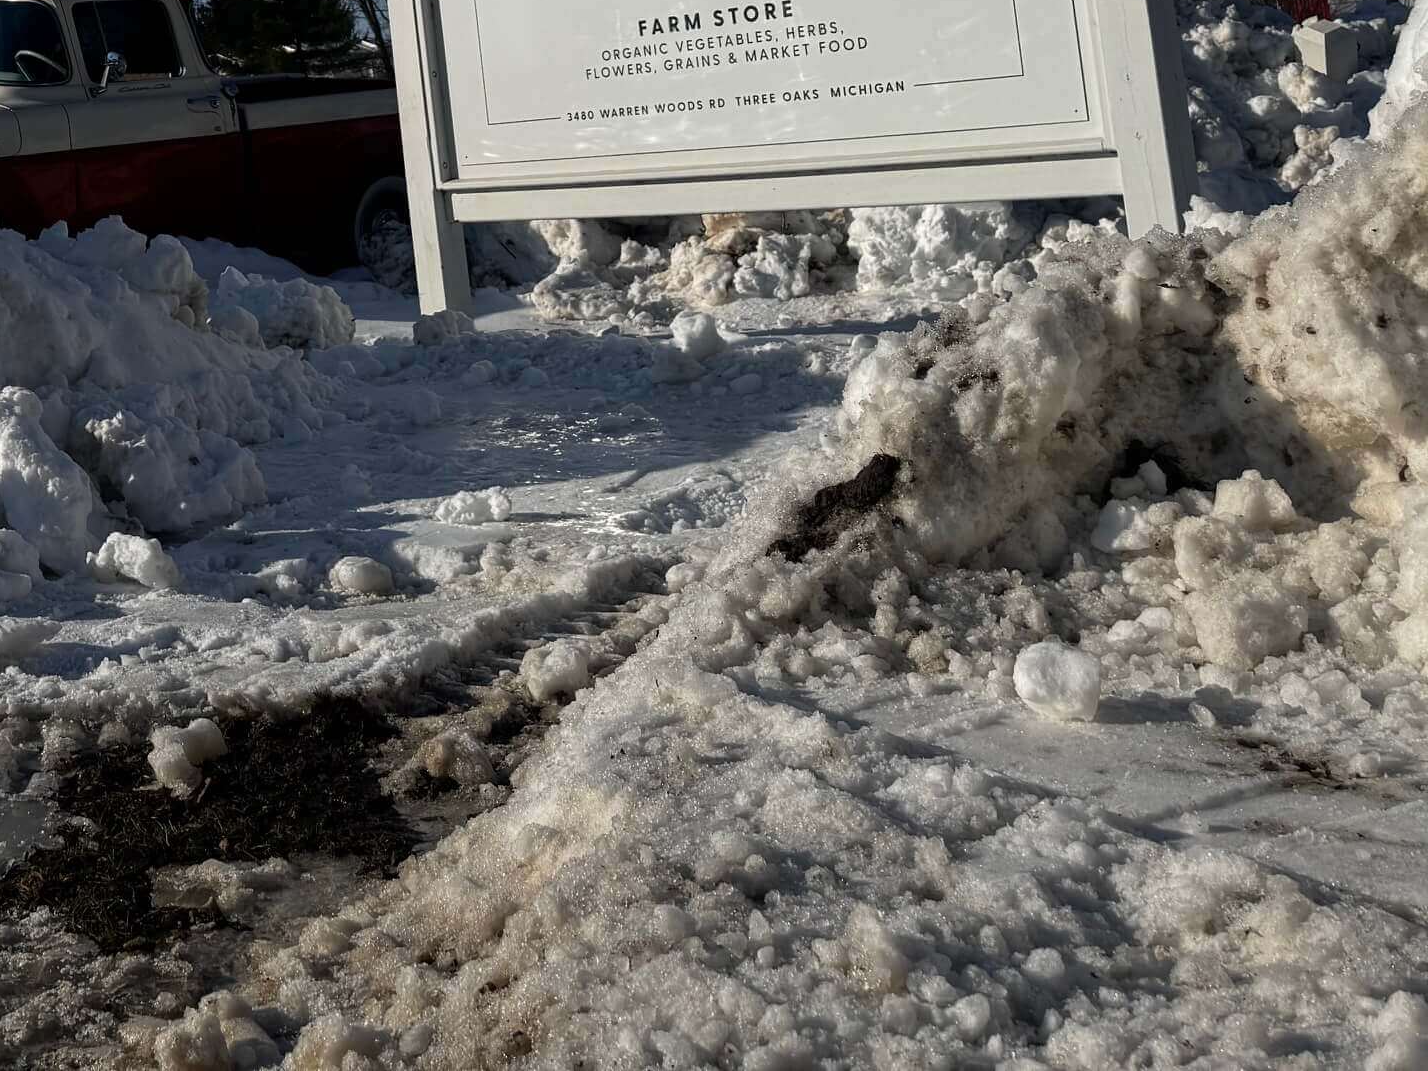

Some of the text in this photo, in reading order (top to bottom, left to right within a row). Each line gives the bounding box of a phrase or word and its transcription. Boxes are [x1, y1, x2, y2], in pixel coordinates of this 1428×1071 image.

[638, 0, 793, 37] FARM STORE
[585, 37, 868, 80] FLOWERS, GRAINS & MARKET FOOD
[601, 21, 845, 62] ORGANIC VEGETABLES, HERBS,
[567, 80, 905, 122] 3480 WARREN WOODS RD THREE OAKS MICHIGAN
